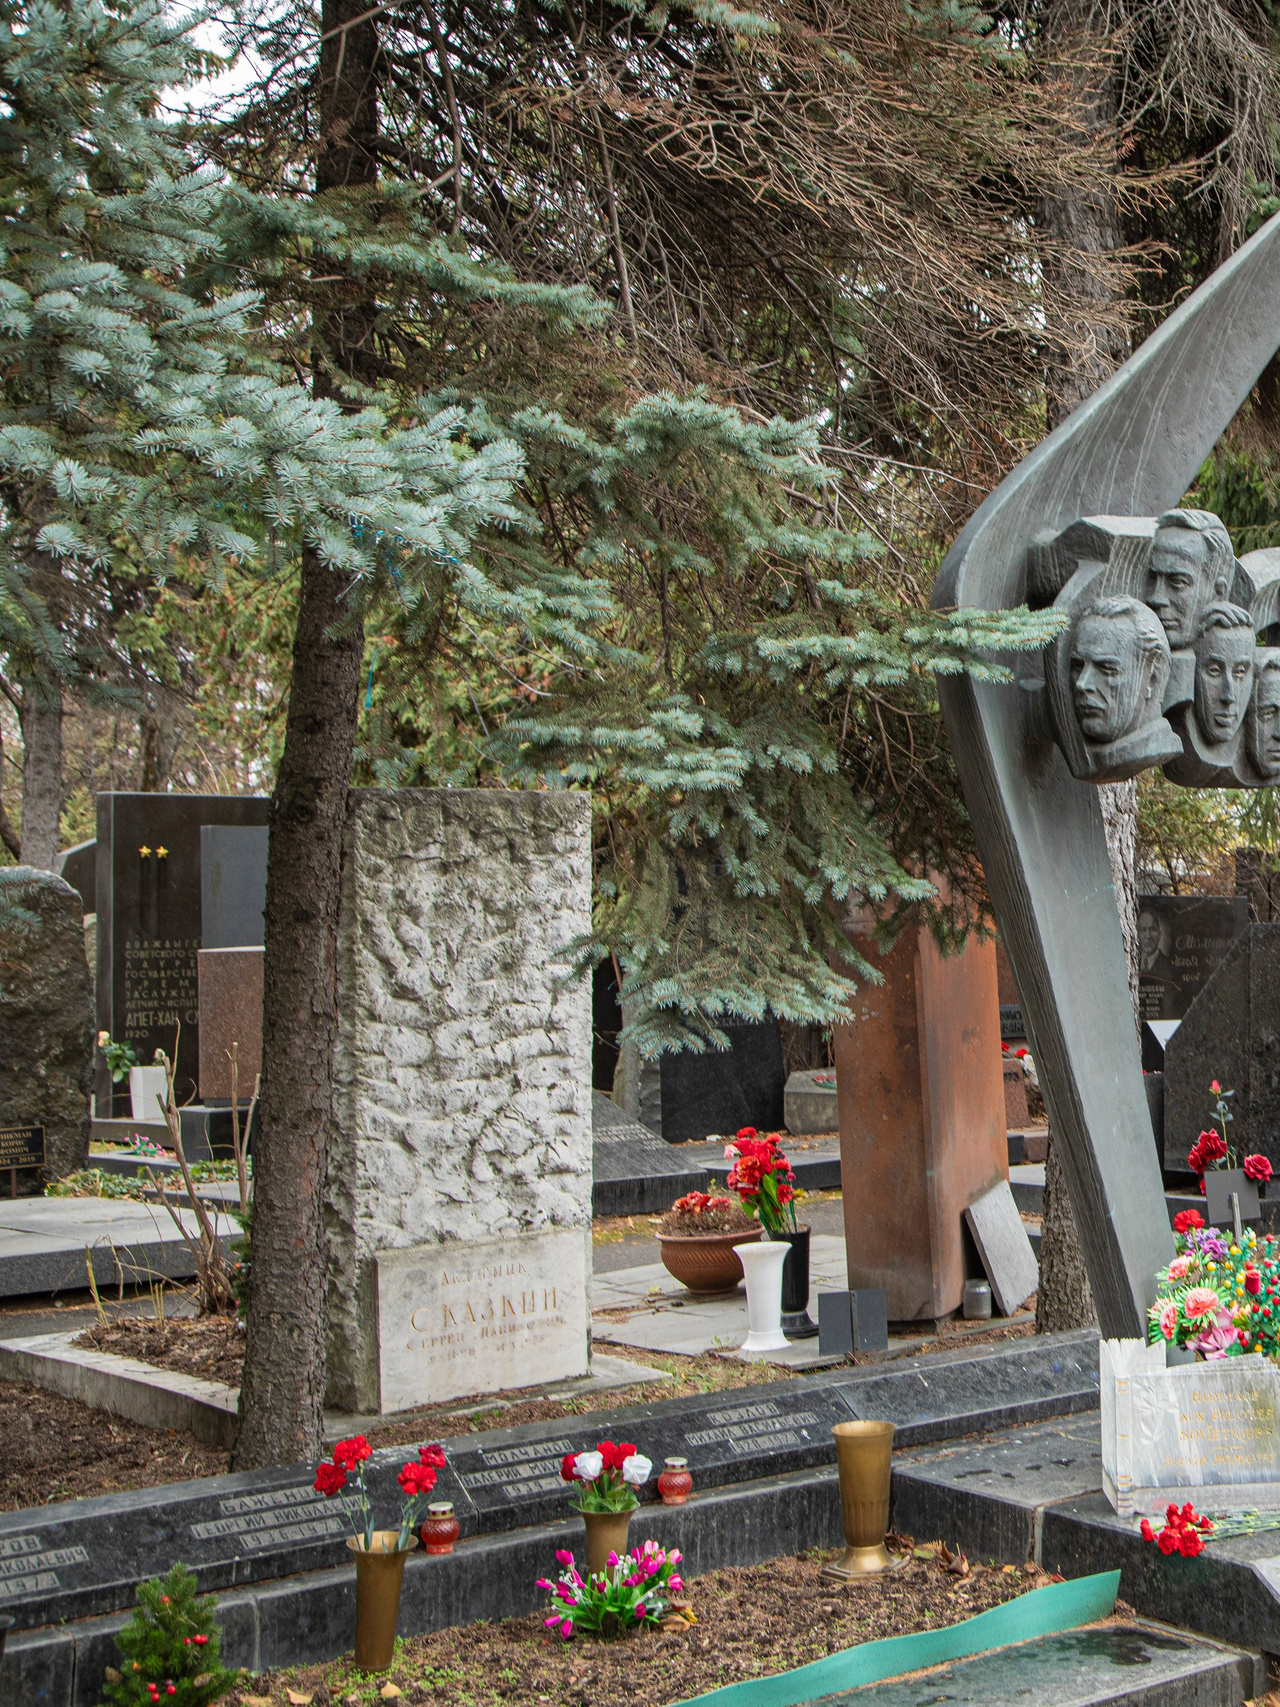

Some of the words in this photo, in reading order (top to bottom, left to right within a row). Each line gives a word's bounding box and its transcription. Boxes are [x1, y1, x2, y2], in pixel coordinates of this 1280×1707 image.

[410, 1287, 557, 1333] СКАЗКИН
[709, 1403, 778, 1425] КОЗЛОВ
[1180, 1411, 1205, 1423] AUX
[1212, 1408, 1274, 1421] PILOTES
[685, 1427, 737, 1446] МИХАИЛ
[739, 1412, 820, 1436] ВАСИЛЬЕВИЧ
[484, 1440, 573, 1466] МОЛЧАНОВ
[193, 1515, 266, 1539] ГЕОРГИЙ
[241, 1520, 343, 1548] 1936-1973
